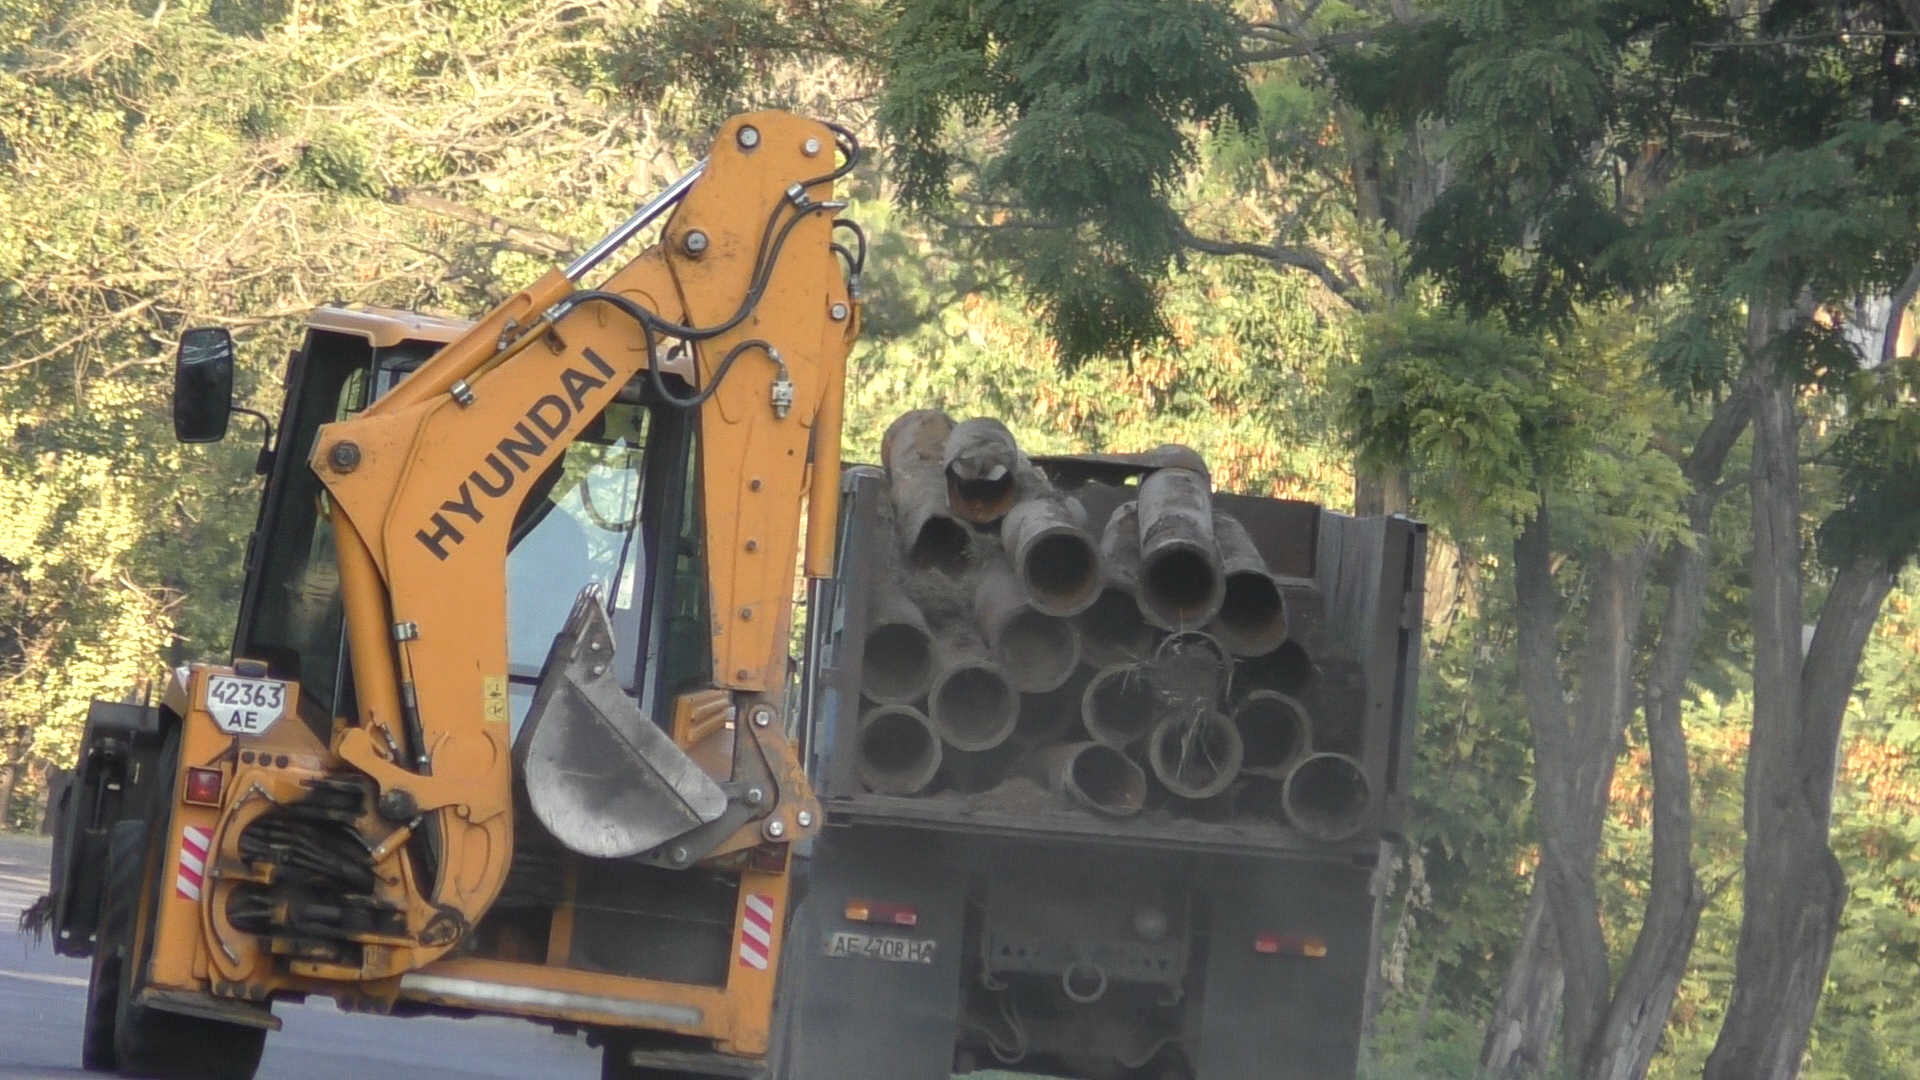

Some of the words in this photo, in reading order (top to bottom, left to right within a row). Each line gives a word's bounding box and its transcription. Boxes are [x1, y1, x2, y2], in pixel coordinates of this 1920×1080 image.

[415, 346, 617, 562] HYUNDAI
[211, 680, 282, 709] 42363
[228, 709, 259, 729] AE
